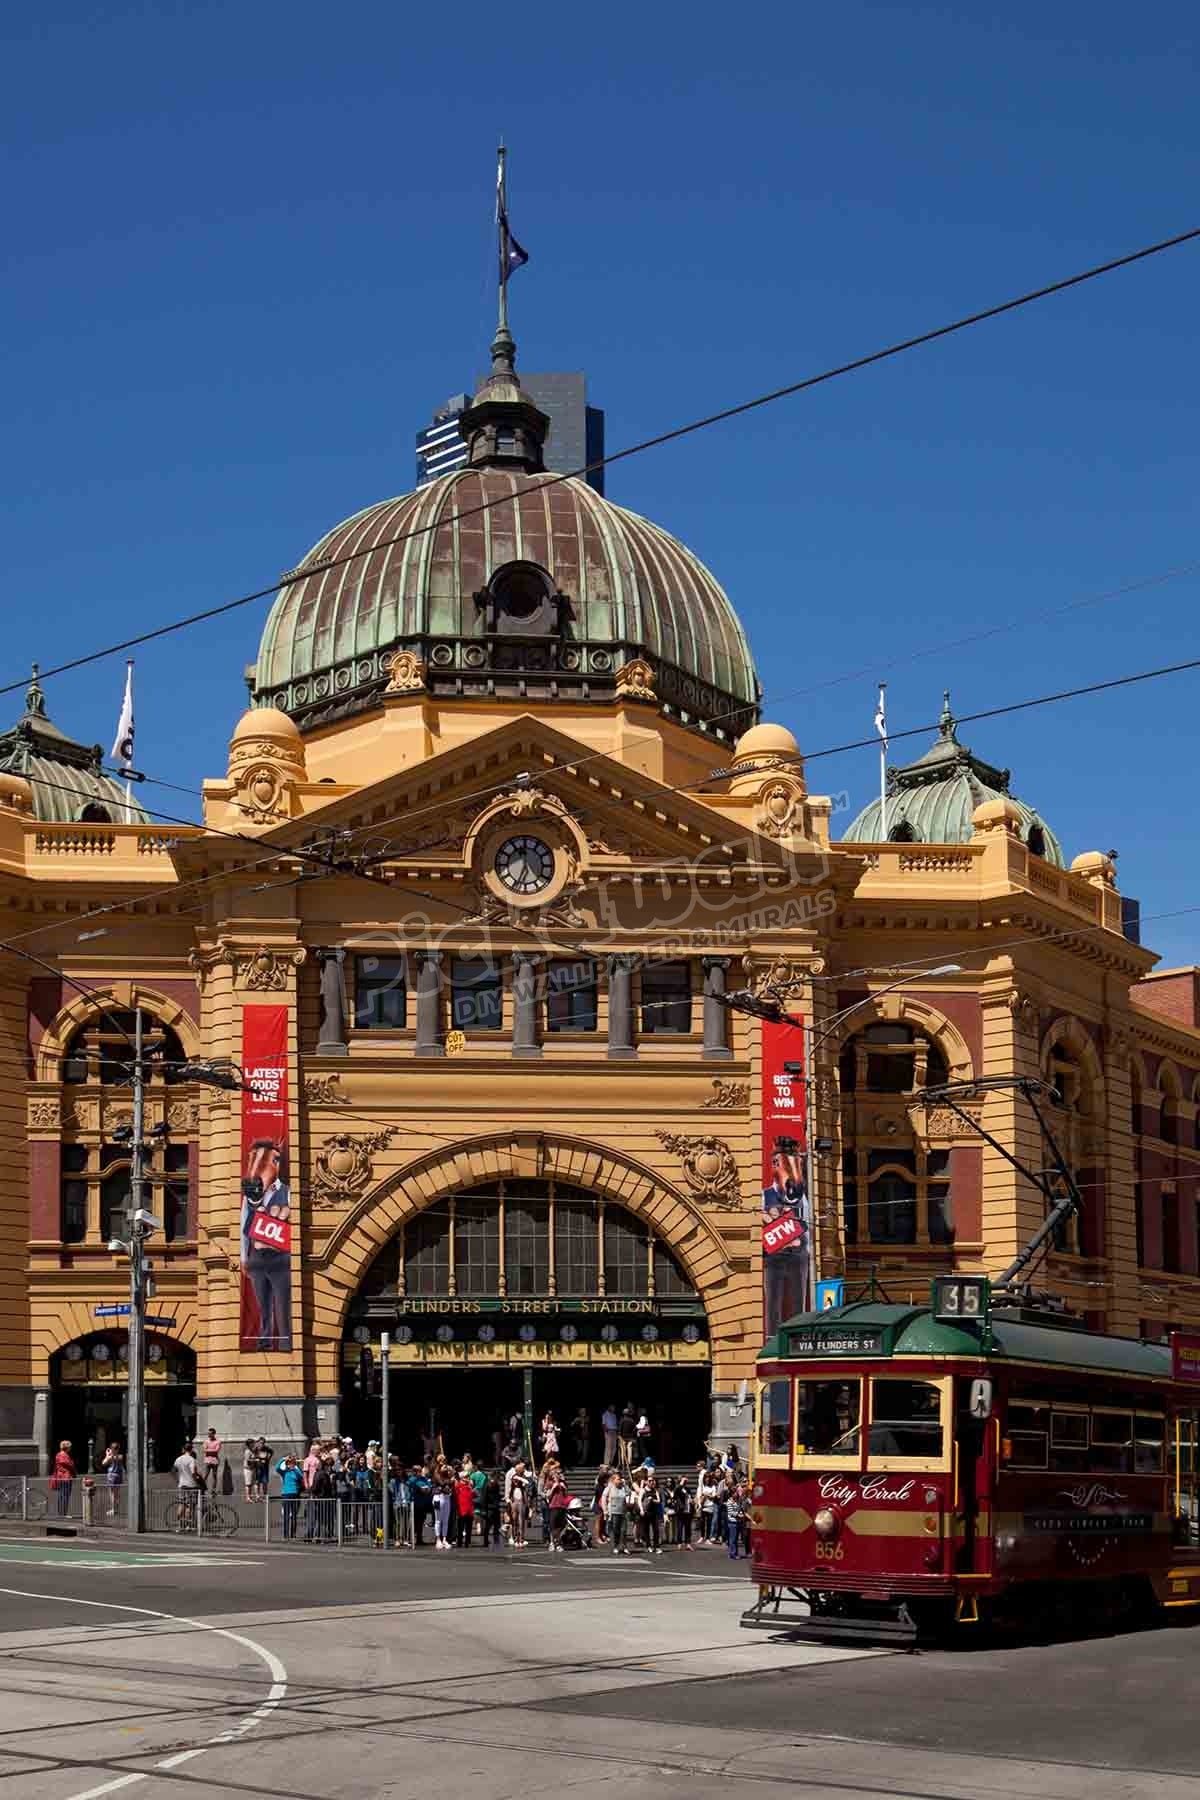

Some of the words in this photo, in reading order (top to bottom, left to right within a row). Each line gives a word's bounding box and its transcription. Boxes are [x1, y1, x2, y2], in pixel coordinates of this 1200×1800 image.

[448, 1034, 463, 1044] CUT
[449, 1043, 464, 1053] OFF
[244, 1068, 286, 1079] LATEST
[772, 1074, 794, 1085] BET
[250, 1079, 280, 1091] ODDS
[252, 1092, 278, 1102] LIVE
[776, 1086, 791, 1097] TO
[772, 1097, 795, 1108] WIN
[254, 1217, 285, 1243] LOL
[764, 1219, 796, 1246] BTW
[944, 1285, 979, 1313] 35
[402, 1300, 481, 1313] FLINDERS
[502, 1300, 561, 1313] STREET
[581, 1300, 653, 1313] STATION
[799, 1341, 813, 1351] VIA
[816, 1340, 860, 1350] FLINDERS
[863, 1339, 875, 1349] ST
[818, 1473, 857, 1506] City
[858, 1474, 916, 1500] Circle
[815, 1541, 844, 1560] 856
